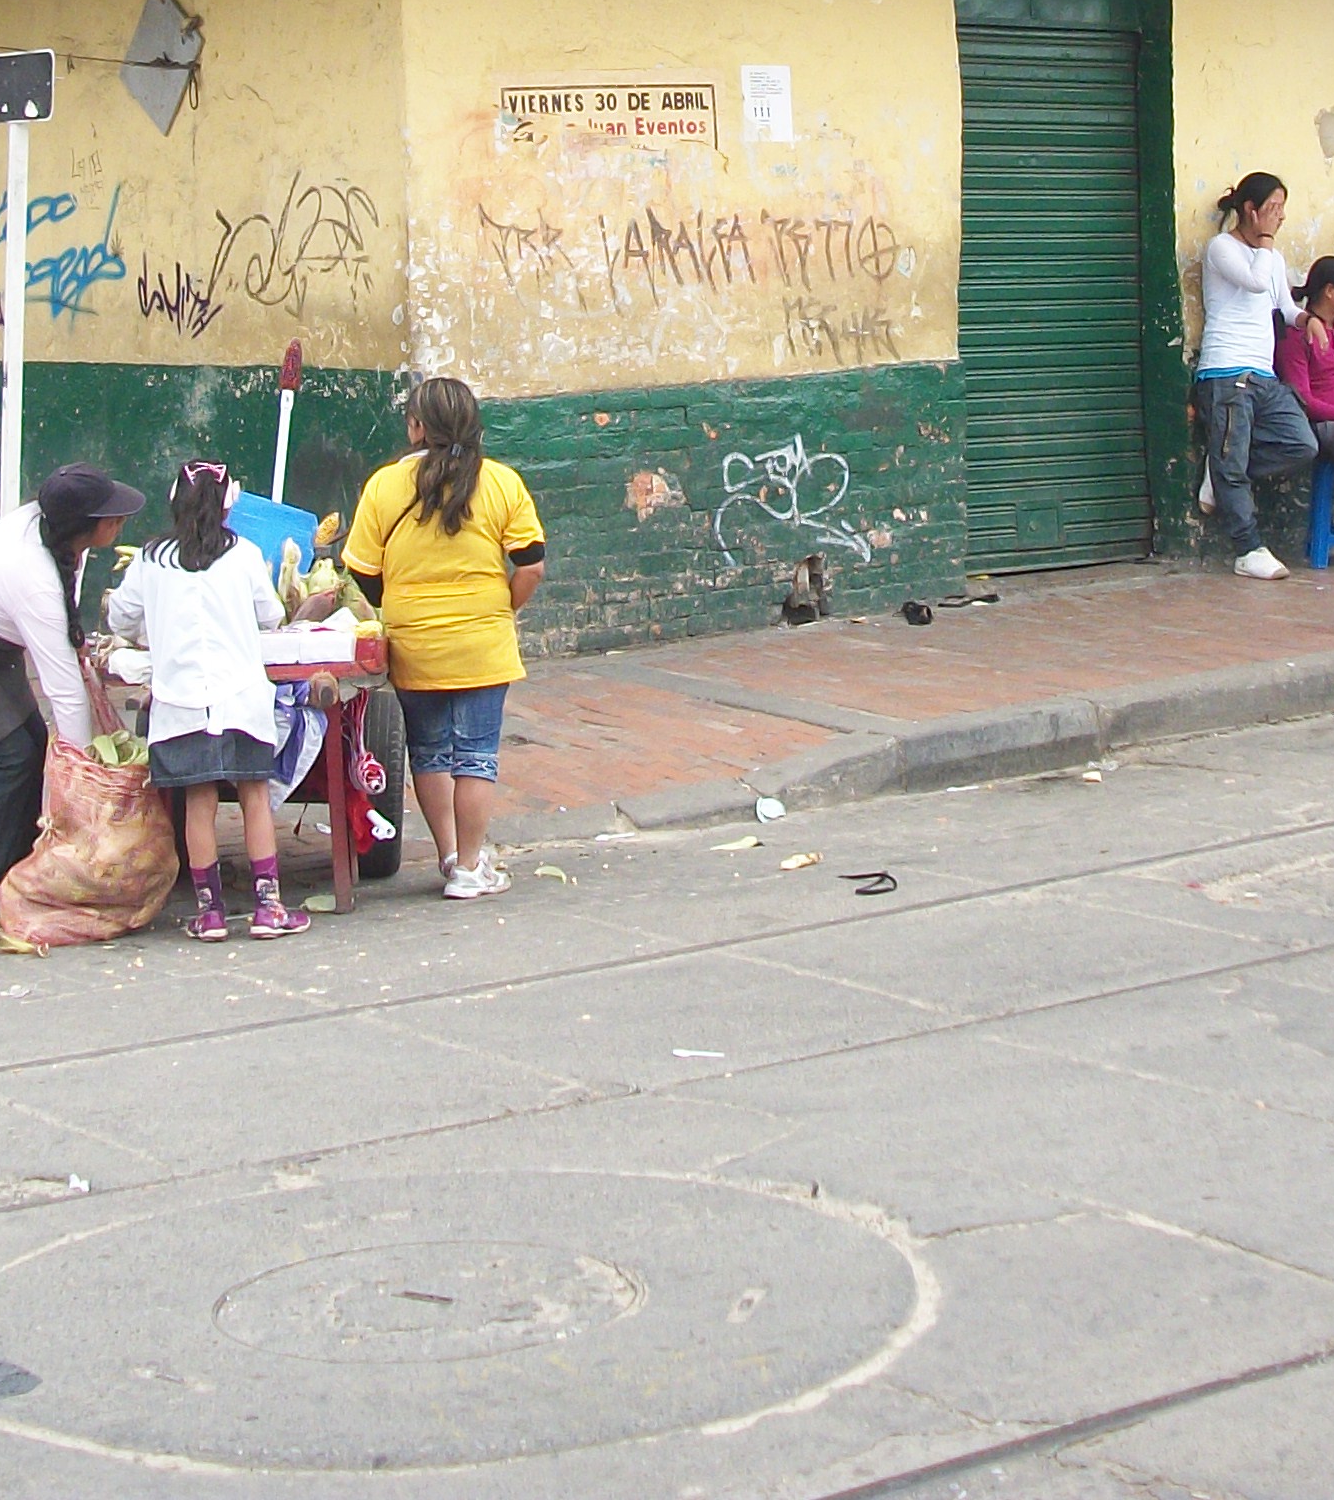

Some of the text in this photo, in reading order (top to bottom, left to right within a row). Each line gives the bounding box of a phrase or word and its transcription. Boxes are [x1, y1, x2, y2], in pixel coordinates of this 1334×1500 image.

[509, 91, 709, 114] VIERNES 30 DE ABRIL
[635, 117, 706, 136] Eventos
